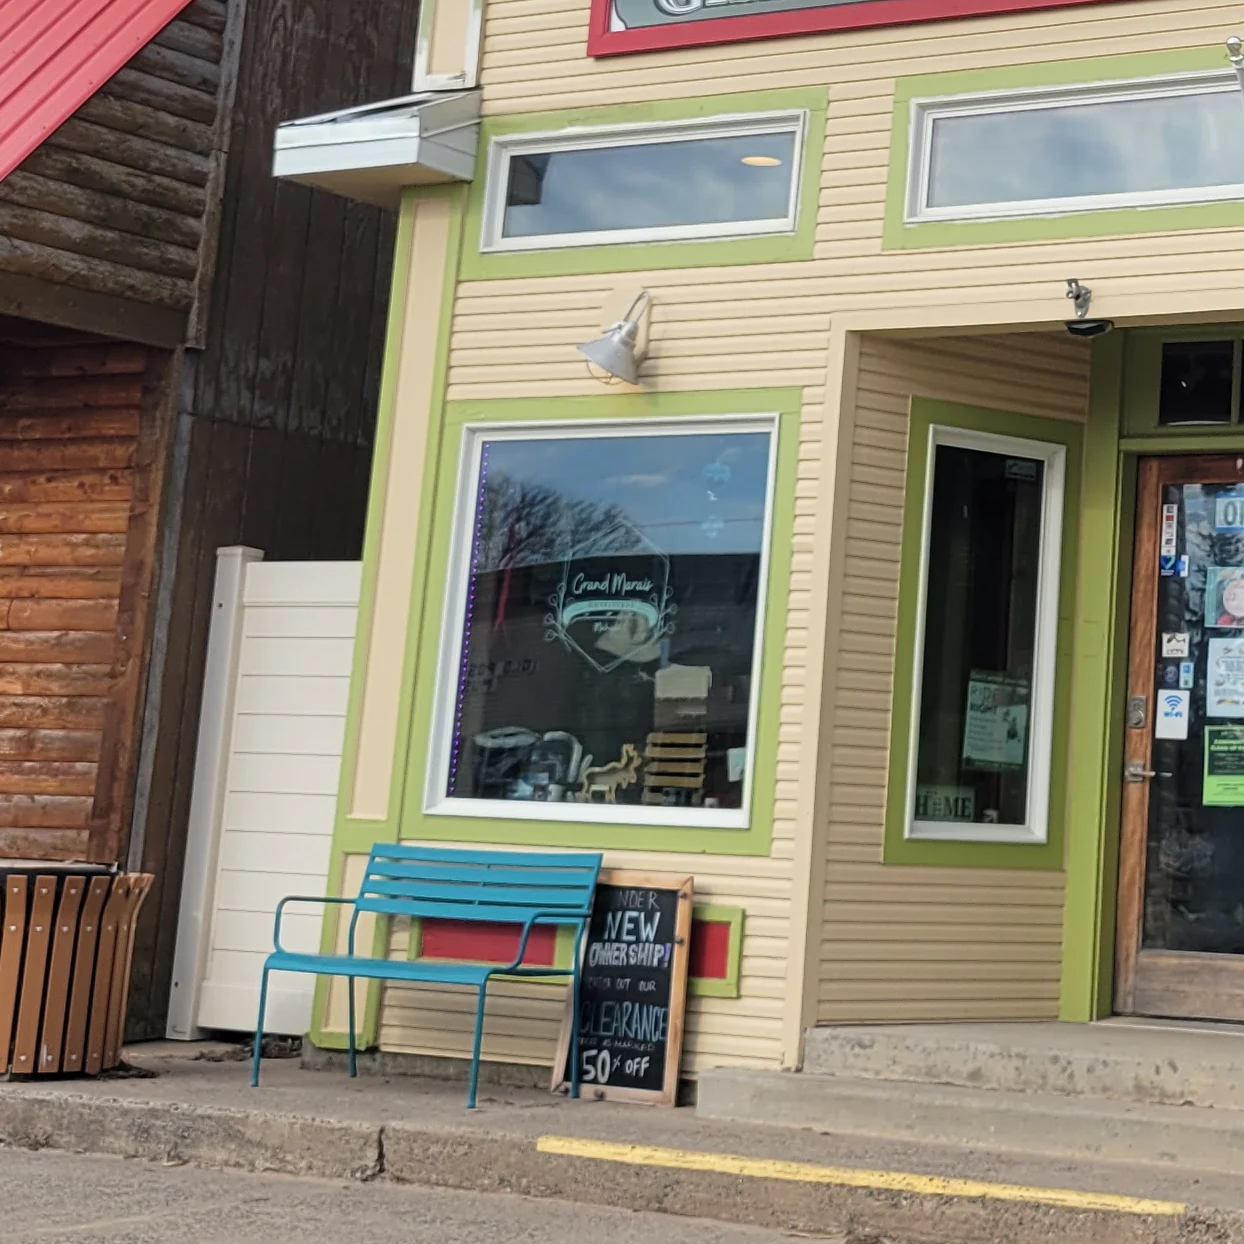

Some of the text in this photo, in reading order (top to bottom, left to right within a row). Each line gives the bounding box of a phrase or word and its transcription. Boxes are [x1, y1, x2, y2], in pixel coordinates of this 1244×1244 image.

[573, 572, 654, 596] Grand Marais
[604, 910, 661, 943] NEW
[638, 979, 657, 992] OUR
[580, 1000, 669, 1043] CLEARANCE
[625, 1055, 651, 1079] OFF
